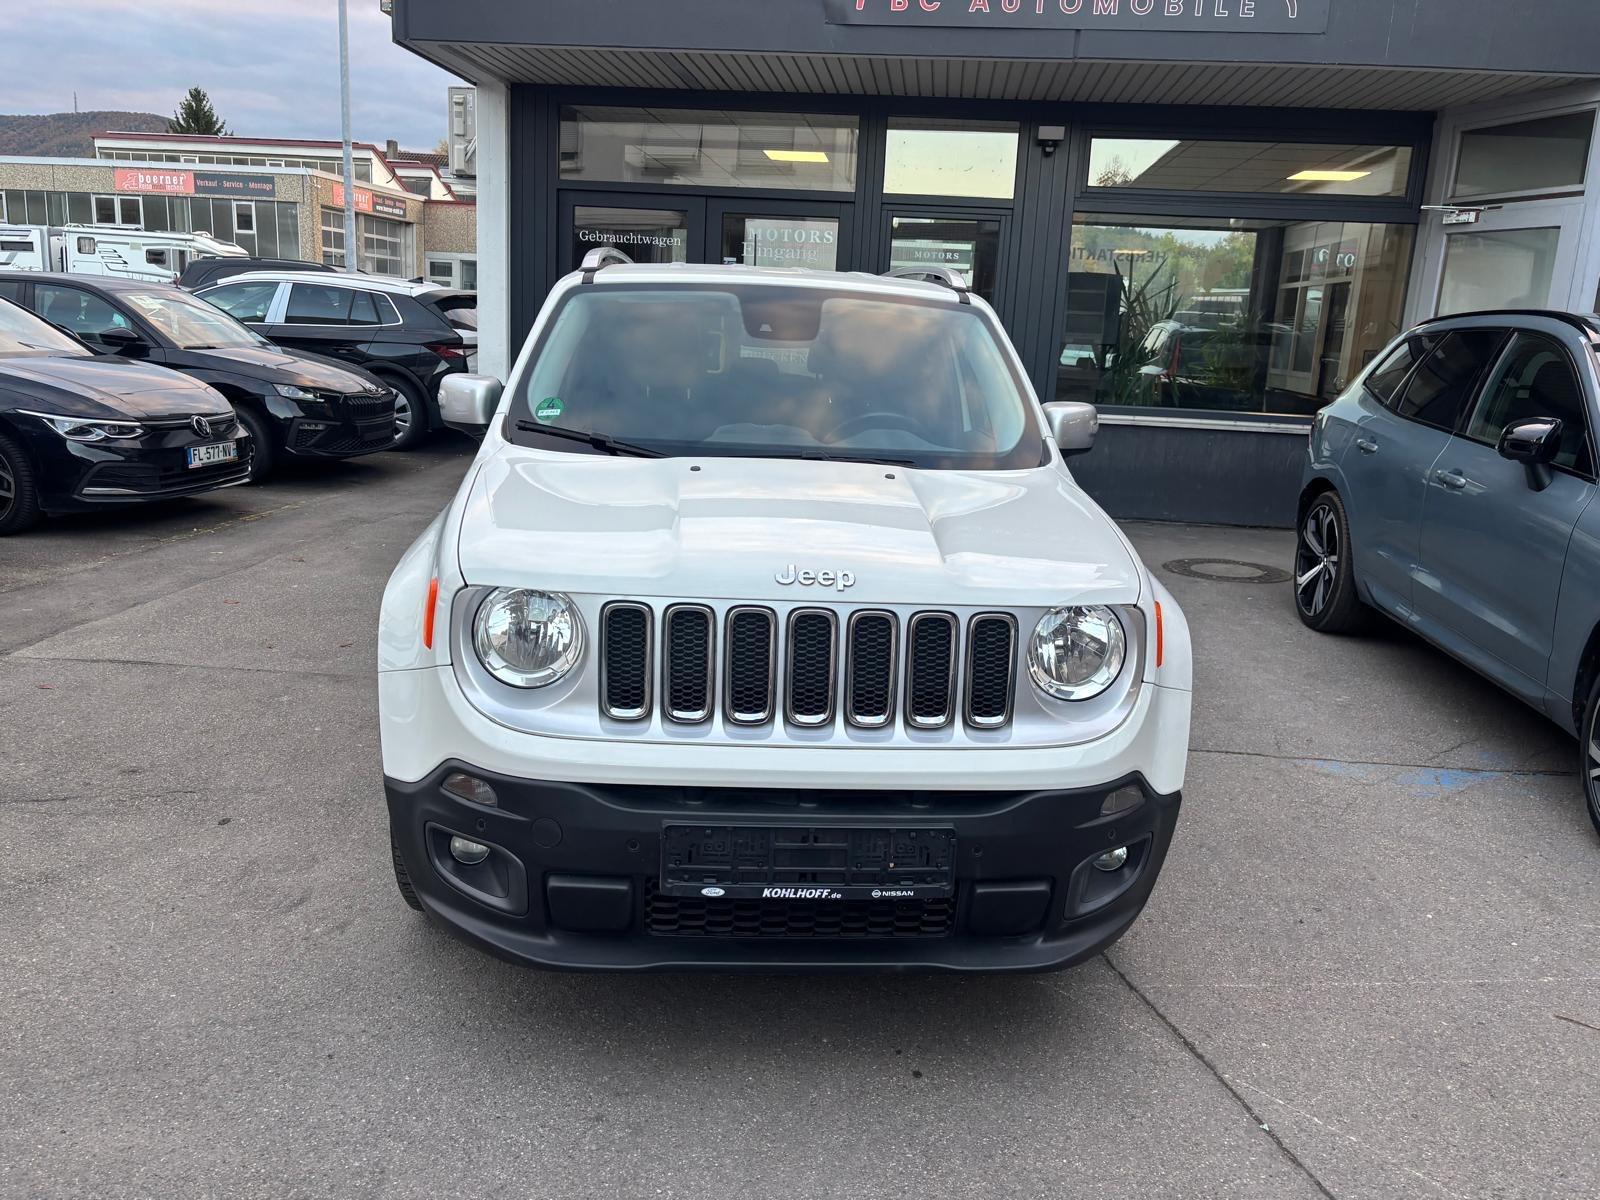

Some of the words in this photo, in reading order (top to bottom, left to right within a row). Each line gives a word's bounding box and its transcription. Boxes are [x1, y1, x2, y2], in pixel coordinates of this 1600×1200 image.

[968, 0, 1256, 18] AUTOMOBILE
[138, 172, 185, 185] boerner
[196, 179, 218, 187] Verkauf
[222, 180, 244, 188] Service
[249, 181, 273, 191] Montage
[579, 230, 681, 247] Gebrauchtwagen
[747, 227, 834, 244] MOTORS
[741, 241, 817, 263] Eingang
[914, 250, 960, 260] MOTORS
[774, 563, 856, 592] Jeep
[761, 887, 842, 899] KOHLHOFF.de
